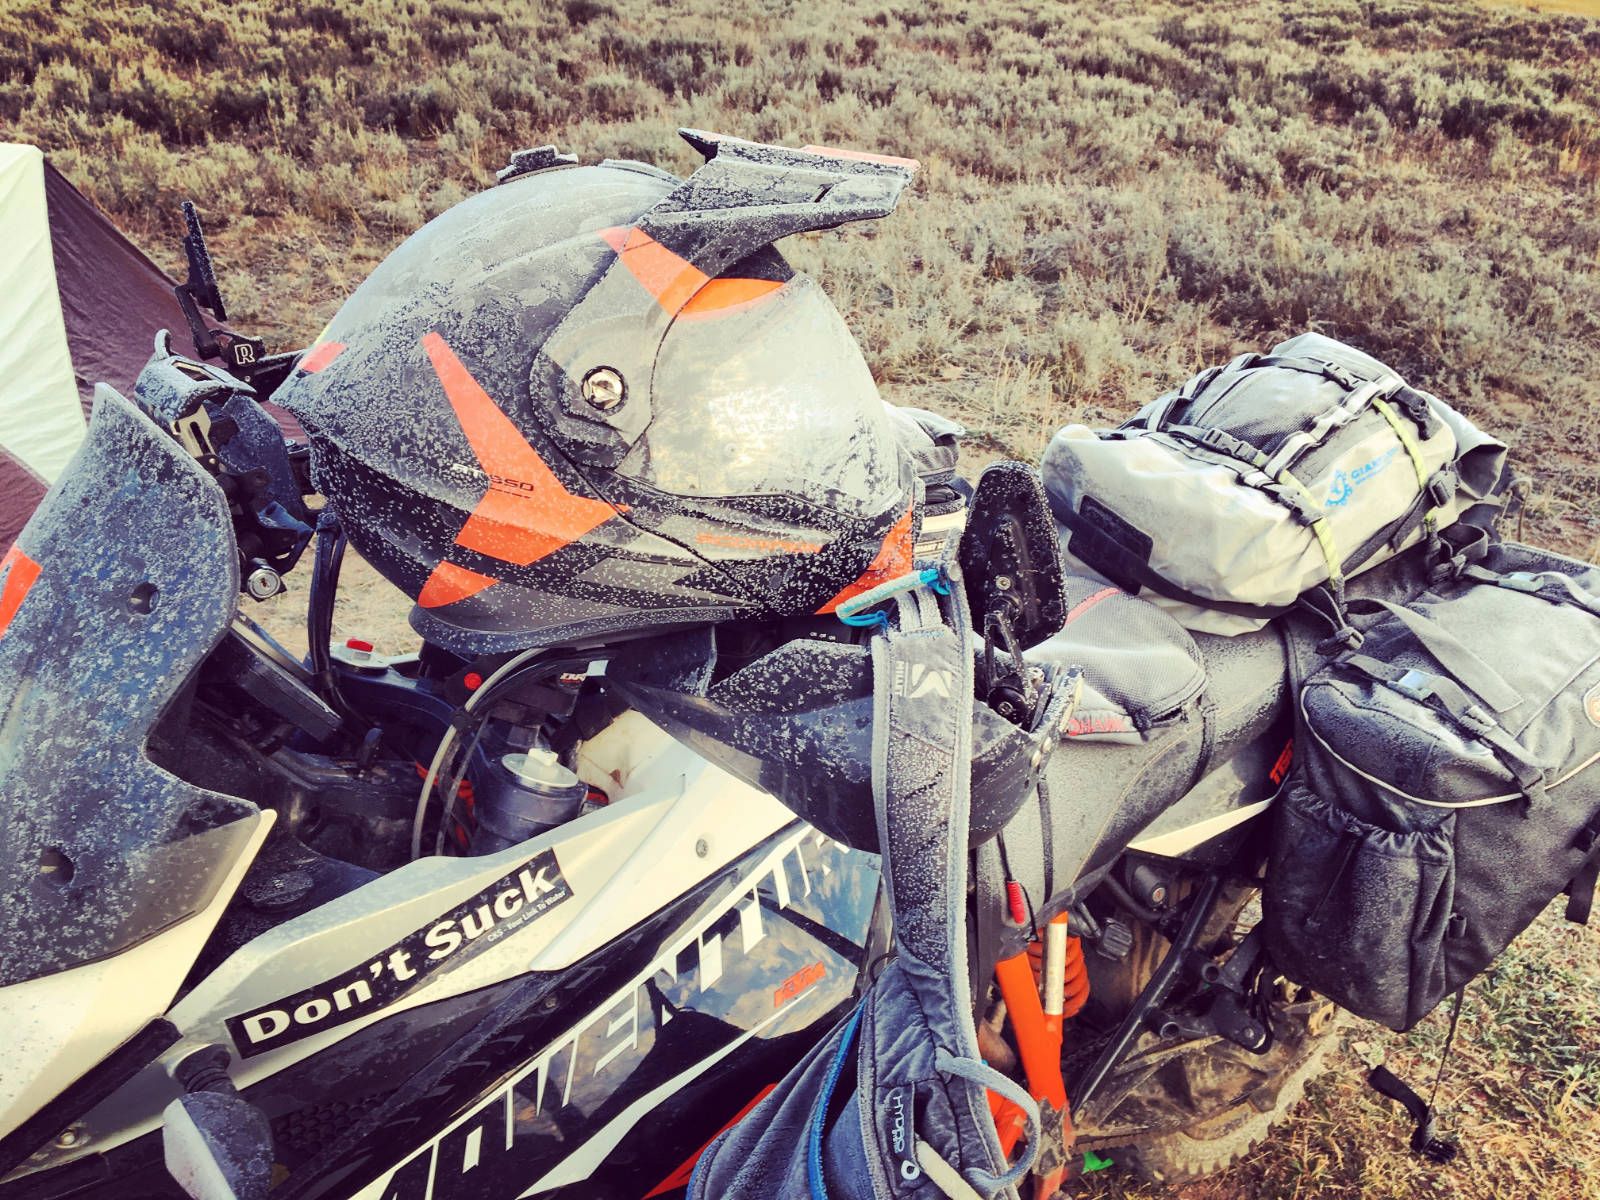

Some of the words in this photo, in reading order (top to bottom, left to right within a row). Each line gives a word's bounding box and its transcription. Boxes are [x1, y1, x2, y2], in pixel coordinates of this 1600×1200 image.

[234, 344, 255, 365] R
[241, 948, 418, 1044] Don't
[423, 866, 555, 960] Suck
